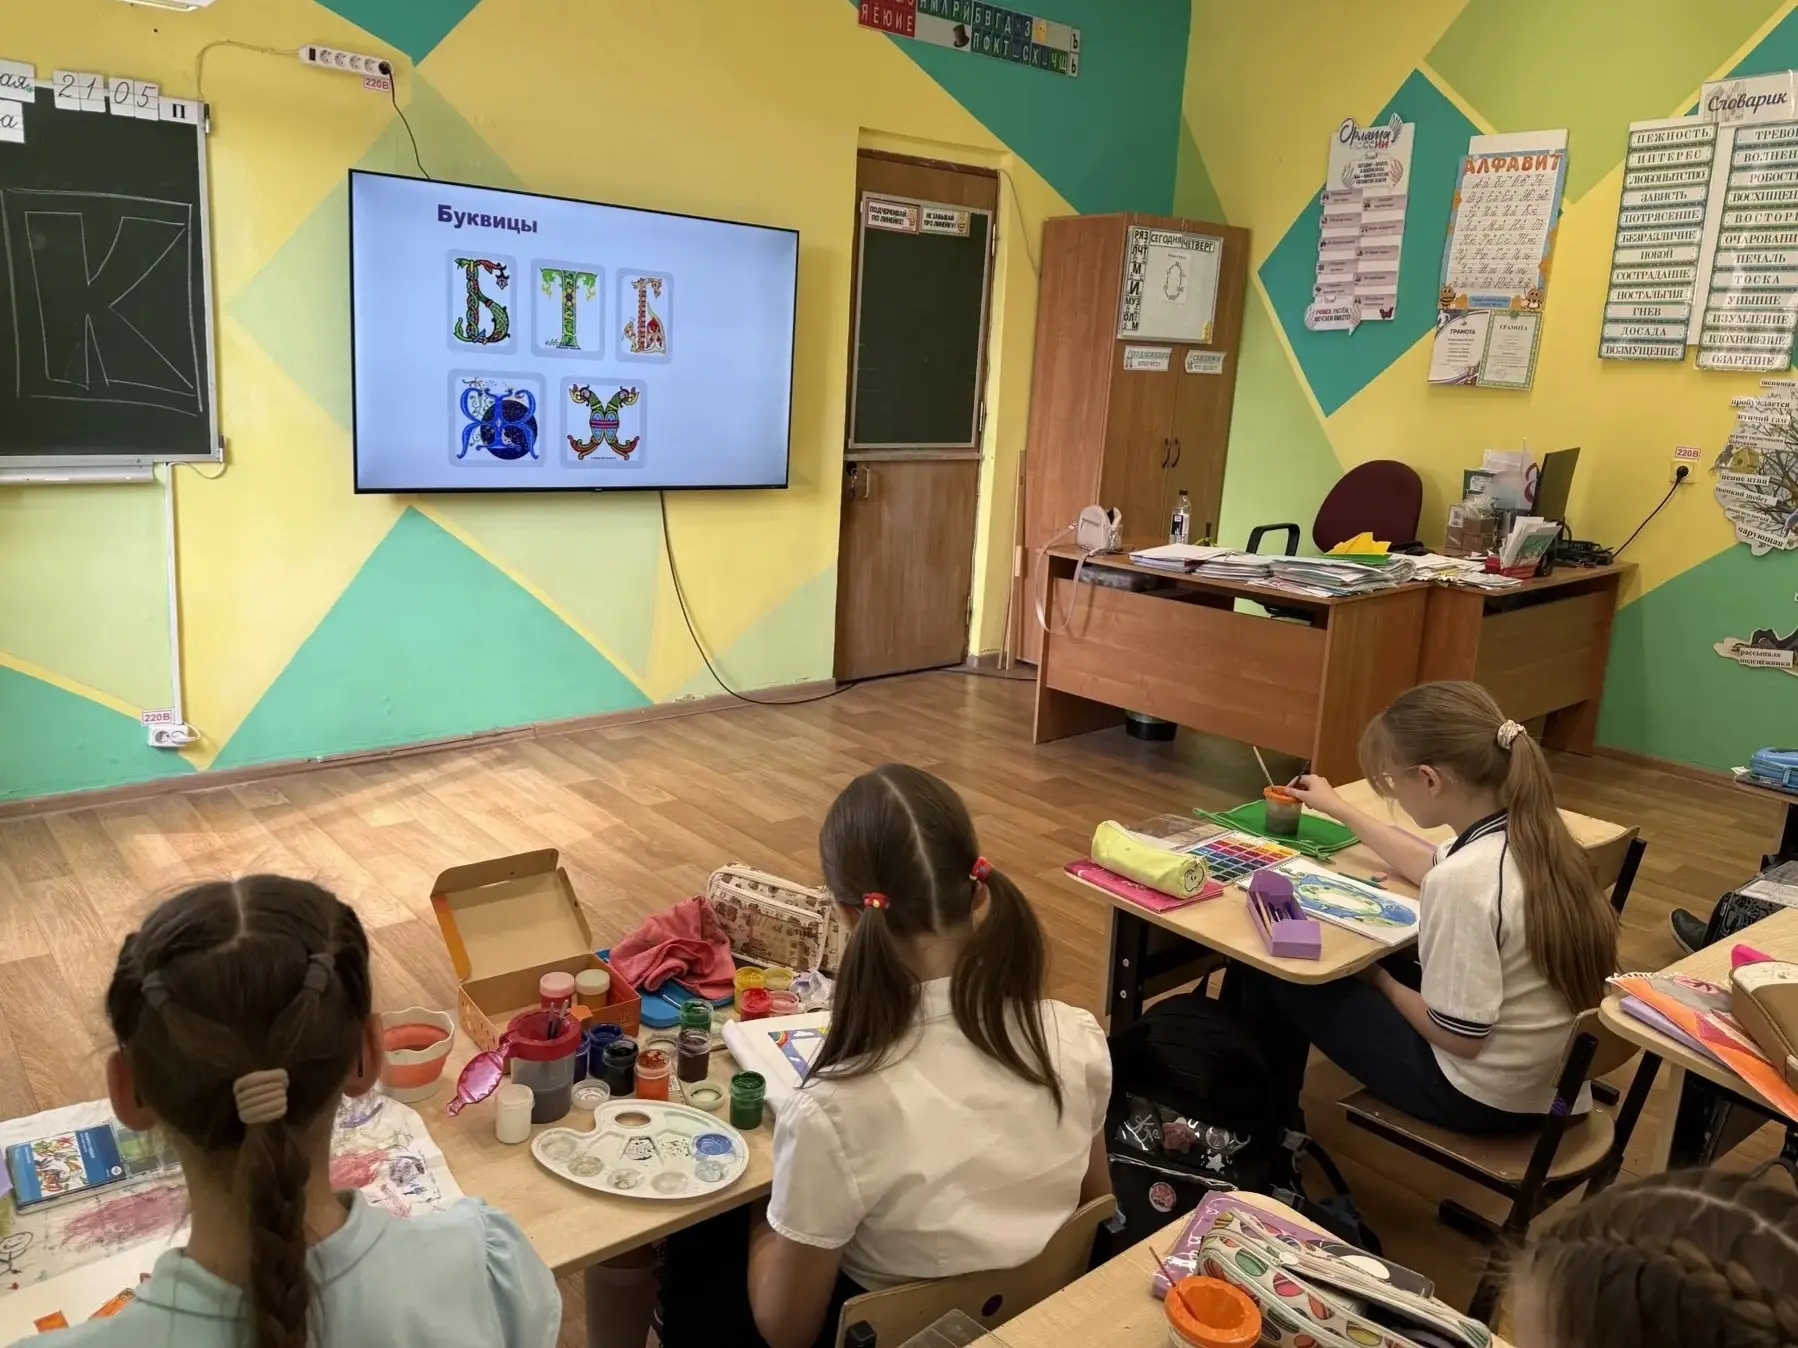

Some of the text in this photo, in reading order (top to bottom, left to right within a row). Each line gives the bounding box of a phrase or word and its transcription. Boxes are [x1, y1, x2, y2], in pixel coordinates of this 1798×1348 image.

[365, 77, 389, 90] 220В
[1708, 92, 1788, 114] Словарик
[1637, 127, 1709, 144] НЕЖНОСТЬ
[1637, 150, 1702, 164] ИНТЕРЕС
[1464, 153, 1562, 174] АЛФАВИТ
[1629, 170, 1706, 185] ЛЮБОПЫТСТВО
[1640, 190, 1688, 202] ЗАВИСТЬ
[437, 203, 539, 234] Буквицы
[1625, 209, 1700, 223] ПОТРЯСЕНИЕ
[1150, 233, 1214, 252] СЕГОДНЯ ЧЕТВЕРГ
[1622, 230, 1697, 243] БЕЗРАЗЛИЧИЕ
[1640, 248, 1673, 260] ПОКОЙ
[1736, 253, 1786, 263] ПЕЧАЛЬ
[1616, 269, 1690, 281] СОСТРАДАНИЕ
[1734, 274, 1780, 284] ТОСКА
[1617, 290, 1683, 299] НОСТАЛЬГИЯ
[1727, 295, 1781, 305] УНЫНИЕ
[1632, 307, 1661, 316] ГНЕВ
[1712, 314, 1789, 325] ИЗУМЛЕНИЕ
[1621, 326, 1667, 337] ДОСАДА
[1709, 334, 1786, 346] ВДОХНОВЕНИЕ
[1605, 345, 1679, 357] ВОЗМУЩЕНИЕ
[1711, 354, 1774, 366] ОЗАРЕНИЕ
[1677, 449, 1699, 458] 220В
[144, 713, 170, 722] 220В
